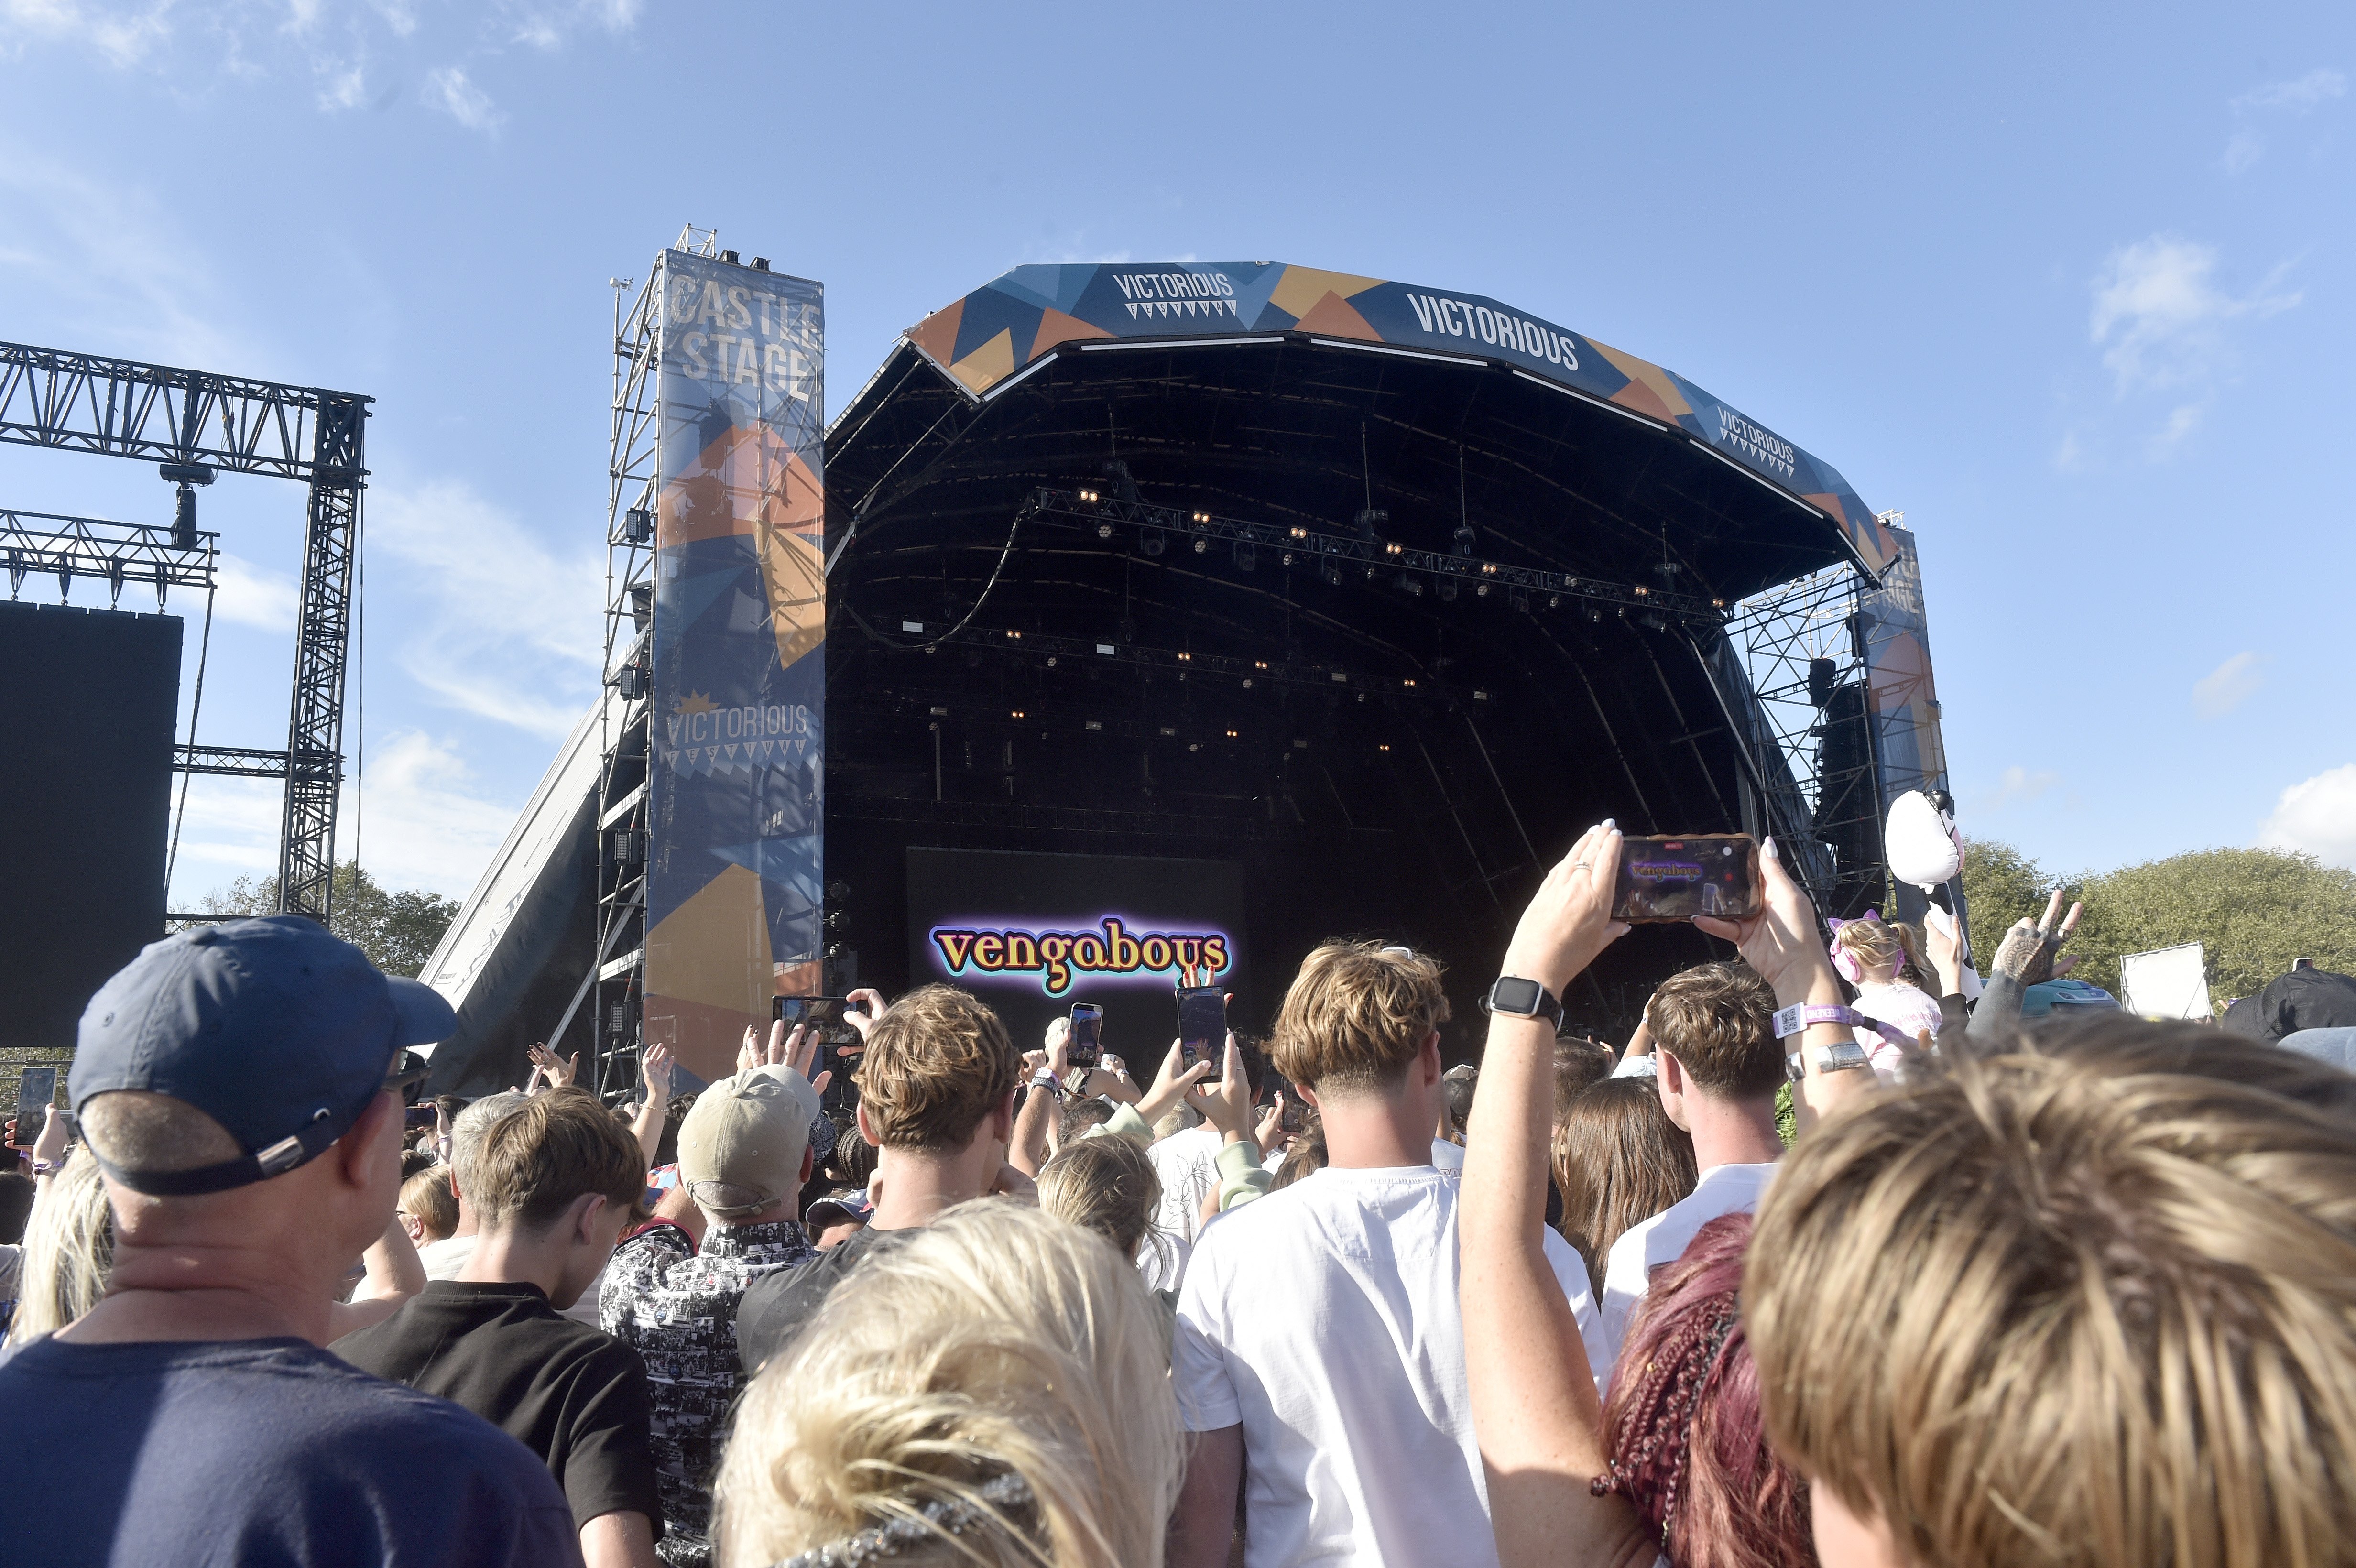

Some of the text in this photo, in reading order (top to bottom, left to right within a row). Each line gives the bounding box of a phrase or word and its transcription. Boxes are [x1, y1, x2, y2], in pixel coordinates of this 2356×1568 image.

[1112, 273, 1233, 300] VICTORIOUS
[1129, 301, 1236, 316] FESTIVAL
[670, 274, 822, 351] CASTLE
[1406, 293, 1579, 371] VICTORIOUS
[682, 331, 809, 402] STAGE
[1717, 406, 1794, 464] VICTORIOUS
[1721, 427, 1793, 476] FESTIVAL
[666, 704, 807, 746] VICTORIOUS
[668, 740, 805, 764] FESTIVAL
[1806, 1008, 1840, 1019] WEEKEND
